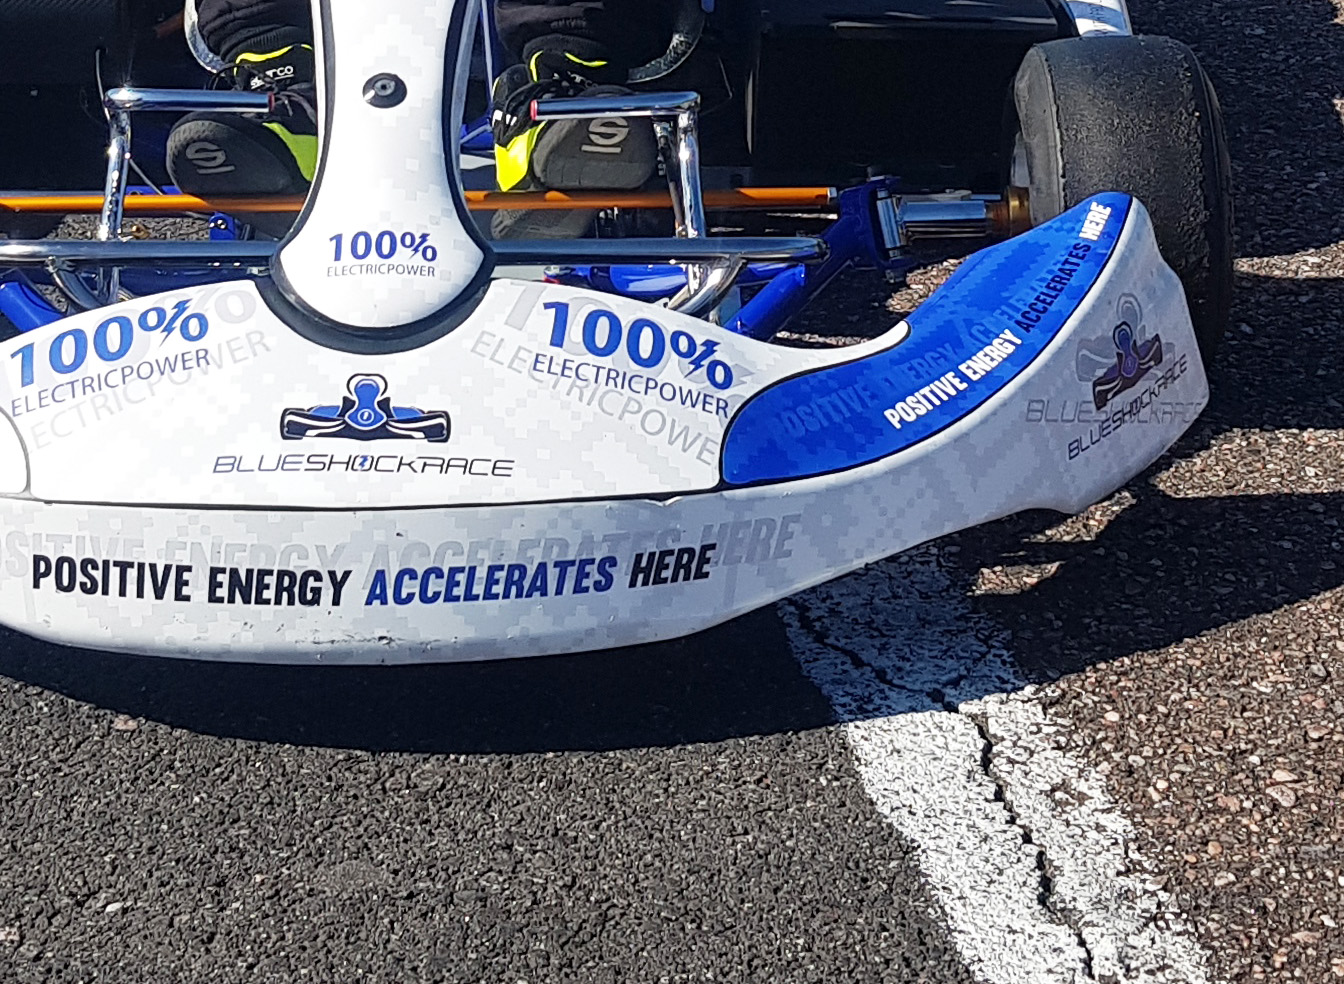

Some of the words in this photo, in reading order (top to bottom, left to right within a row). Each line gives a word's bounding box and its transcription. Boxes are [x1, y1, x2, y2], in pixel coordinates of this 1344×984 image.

[326, 263, 436, 277] ELECTRICPOWER
[329, 230, 438, 262] 100%
[9, 298, 209, 388] 100%
[543, 301, 734, 390] 100%
[883, 371, 968, 430] POSITIVE
[958, 328, 1023, 382] ENERGY
[1013, 241, 1093, 334] ACCELERATES
[1079, 200, 1112, 241] HERE
[10, 348, 211, 418] ELECTRICPOWER
[532, 353, 730, 419] ELECTRICPOWER
[1067, 353, 1189, 461] BLUESHOCKRACE
[212, 454, 515, 477] BLUESHOCKRACE
[32, 554, 194, 602] POSITIVE
[207, 566, 353, 607] ENERGY
[364, 555, 618, 606] ACCELERATES
[628, 543, 717, 588] HERE
